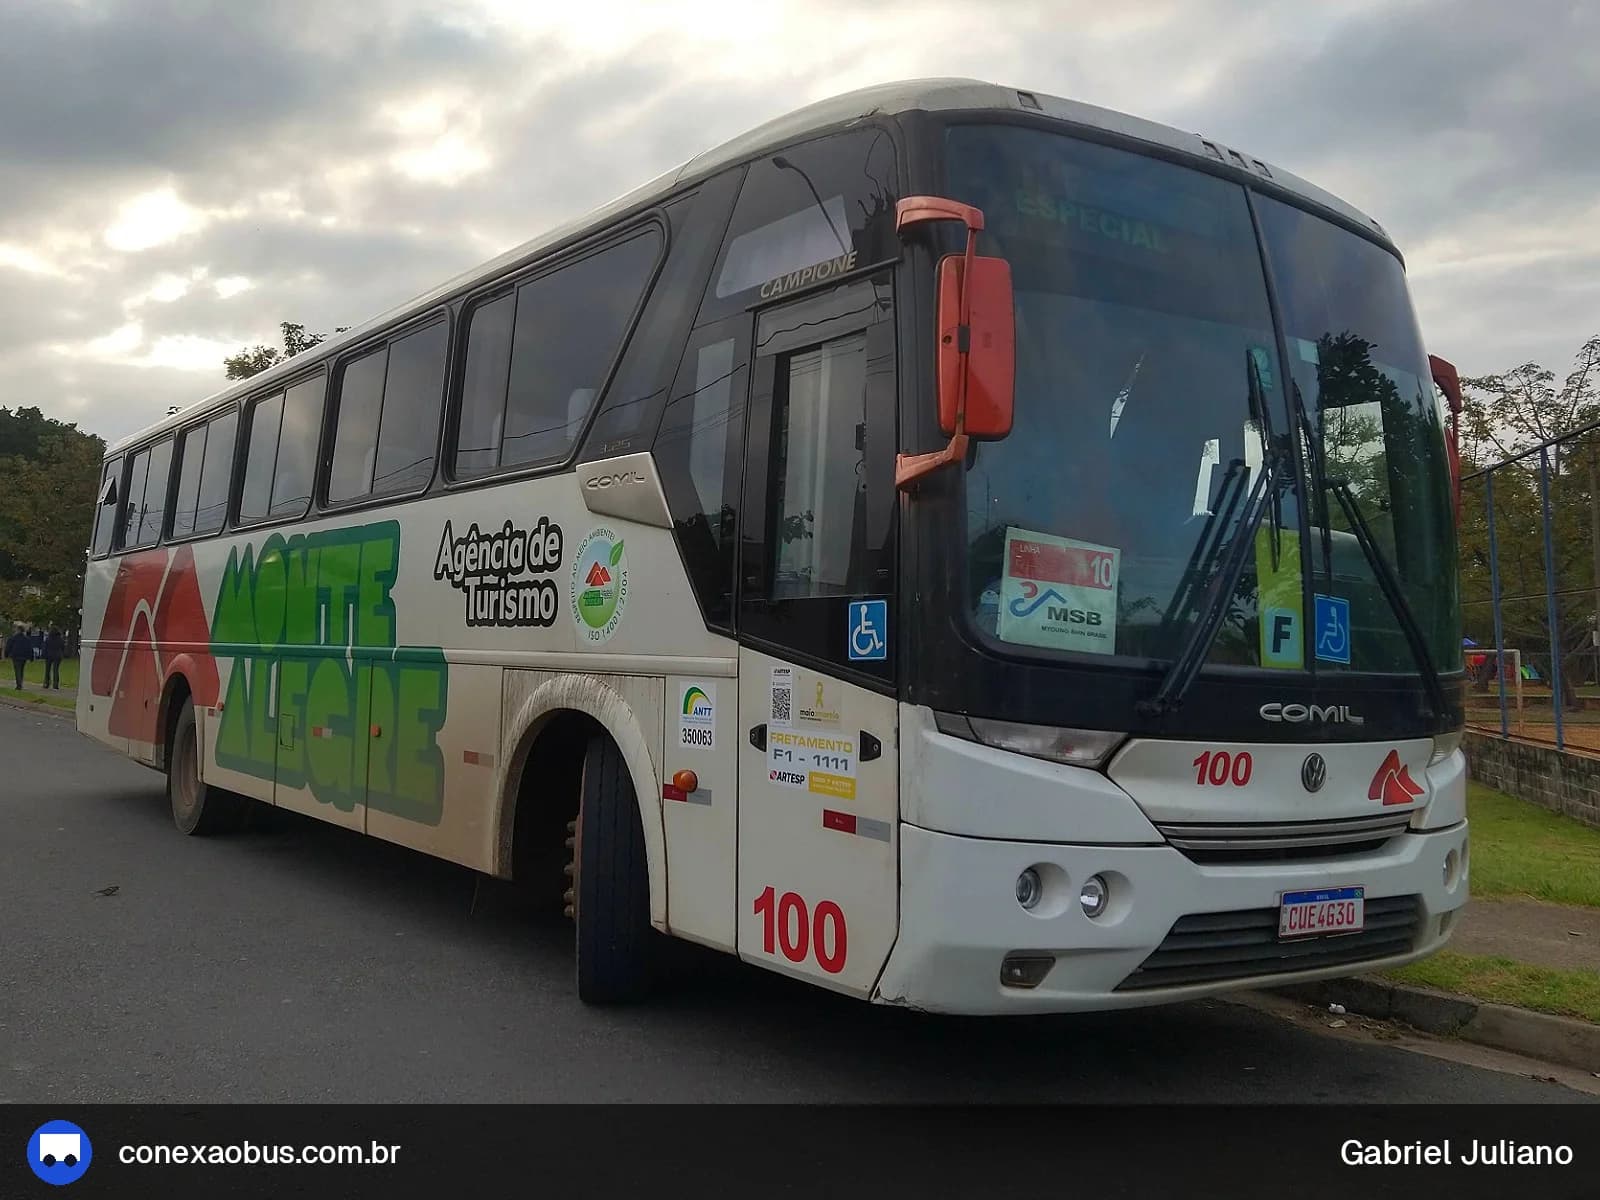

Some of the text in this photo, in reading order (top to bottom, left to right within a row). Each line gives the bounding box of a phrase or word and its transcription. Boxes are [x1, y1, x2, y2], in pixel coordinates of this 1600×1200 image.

[760, 250, 858, 299] CAMPIONE
[586, 471, 645, 490] COMIL
[434, 516, 563, 587] Agência de
[576, 539, 588, 561] MEIO
[1091, 556, 1113, 587] 10
[210, 520, 399, 651] MONTE
[463, 576, 559, 627] Turismo
[1048, 606, 1102, 626] MSB
[588, 630, 600, 640] ISO
[1272, 615, 1293, 653] F
[693, 706, 713, 716] ANTT
[1259, 702, 1365, 725] COMIL
[215, 655, 447, 825] ALEGRE
[682, 728, 713, 746] 350063
[769, 732, 853, 753] FRETAMENTO
[773, 748, 793, 762] F1
[812, 754, 849, 771] 1111
[1193, 750, 1253, 787] 100
[776, 770, 806, 785] ARTESP
[1288, 901, 1355, 930] CUE4G30
[753, 885, 848, 974] 100
